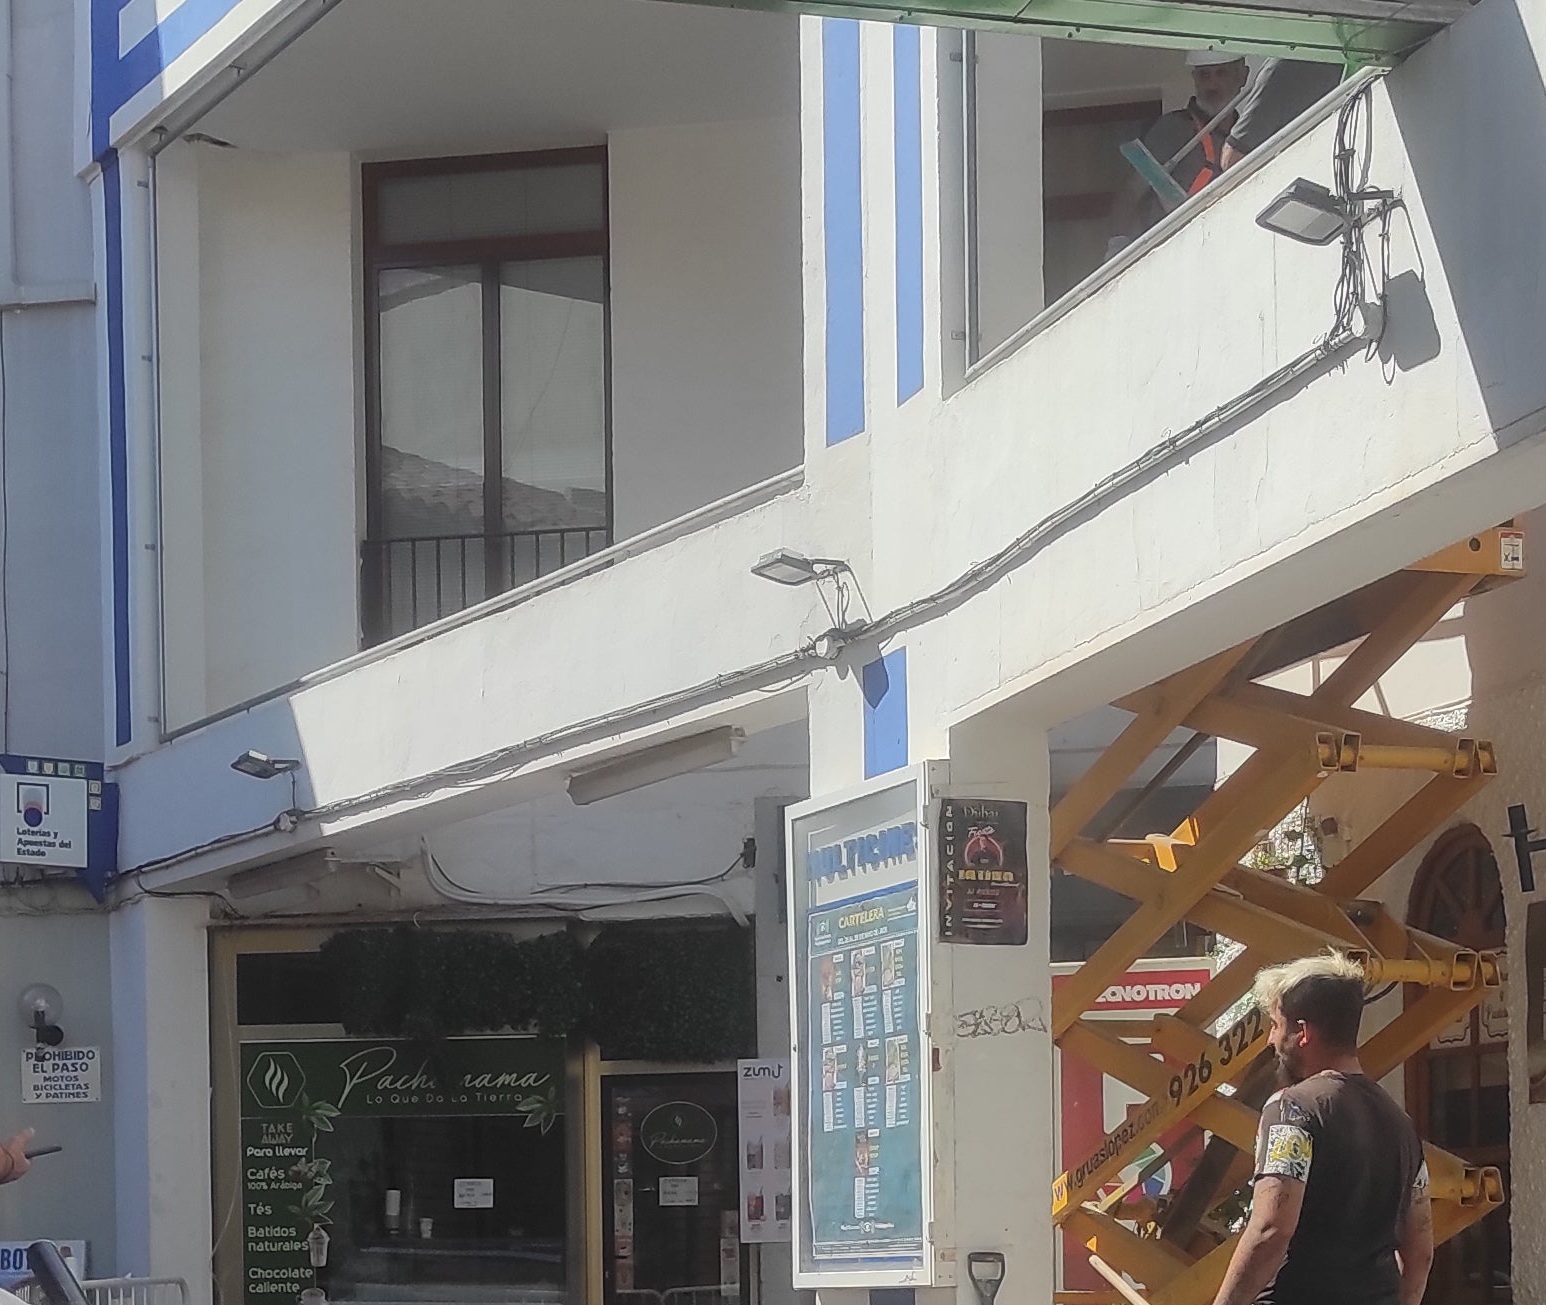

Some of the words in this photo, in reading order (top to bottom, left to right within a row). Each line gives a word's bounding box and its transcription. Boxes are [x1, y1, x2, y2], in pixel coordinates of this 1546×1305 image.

[17, 838, 56, 848] Apuestas
[58, 840, 72, 849] del
[17, 848, 46, 857] Estado
[839, 906, 885, 929] CARTELERA
[33, 1063, 47, 1073] EL
[52, 1062, 89, 1073] PASO
[43, 1075, 79, 1083] MOTOS
[1168, 1052, 1213, 1108] 926
[33, 1083, 90, 1092] BICICLETAS
[45, 1091, 89, 1099] PATINES
[261, 1123, 294, 1133] TAKE
[261, 1134, 295, 1144] AWAY
[247, 1166, 286, 1180] Cafés
[248, 1203, 273, 1216] Tés
[248, 1225, 297, 1237] Batidos
[248, 1239, 309, 1252] naturales
[249, 1267, 314, 1279] Chocolate
[249, 1281, 300, 1293] caliente
